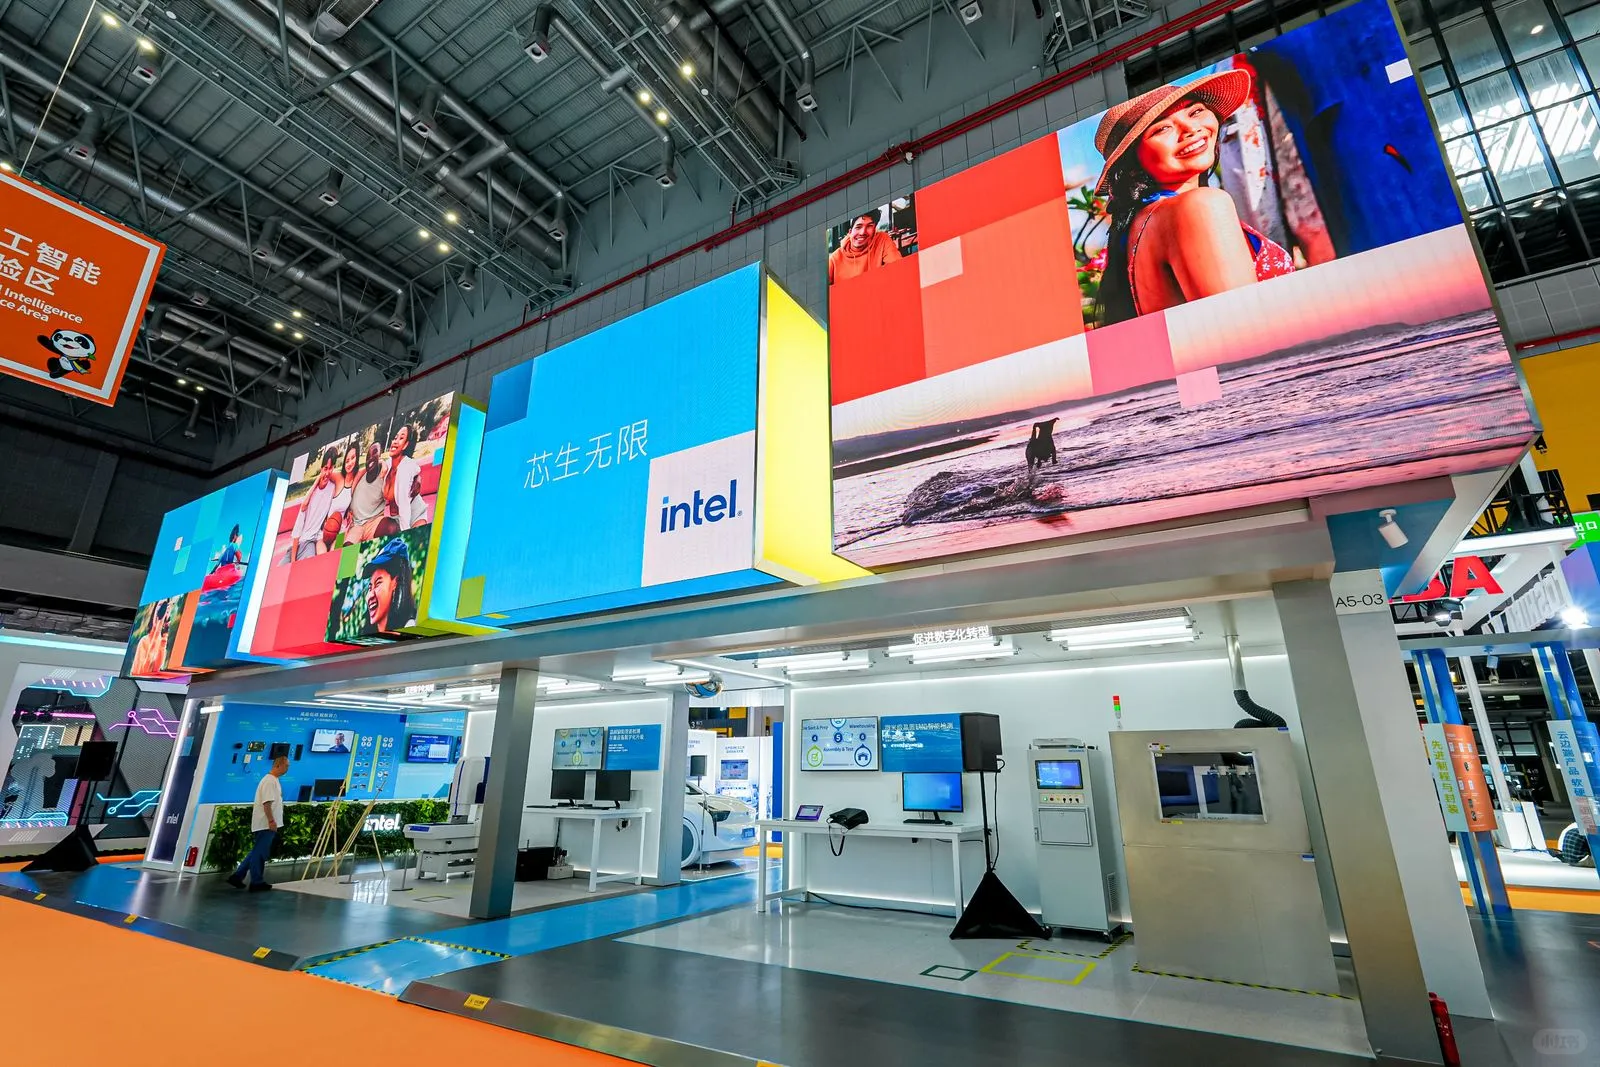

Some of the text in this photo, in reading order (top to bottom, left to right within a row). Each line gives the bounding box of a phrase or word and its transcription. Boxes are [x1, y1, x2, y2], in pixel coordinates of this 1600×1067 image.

[4, 288, 83, 324] Intelligence
[17, 304, 49, 322] Area
[523, 419, 648, 489] 芯生无限
[1335, 593, 1384, 608] A5-03
[912, 625, 990, 644] 促进数字化转型
[1557, 731, 1580, 776] 云边端产品
[1432, 740, 1460, 815] 先进制程与封装
